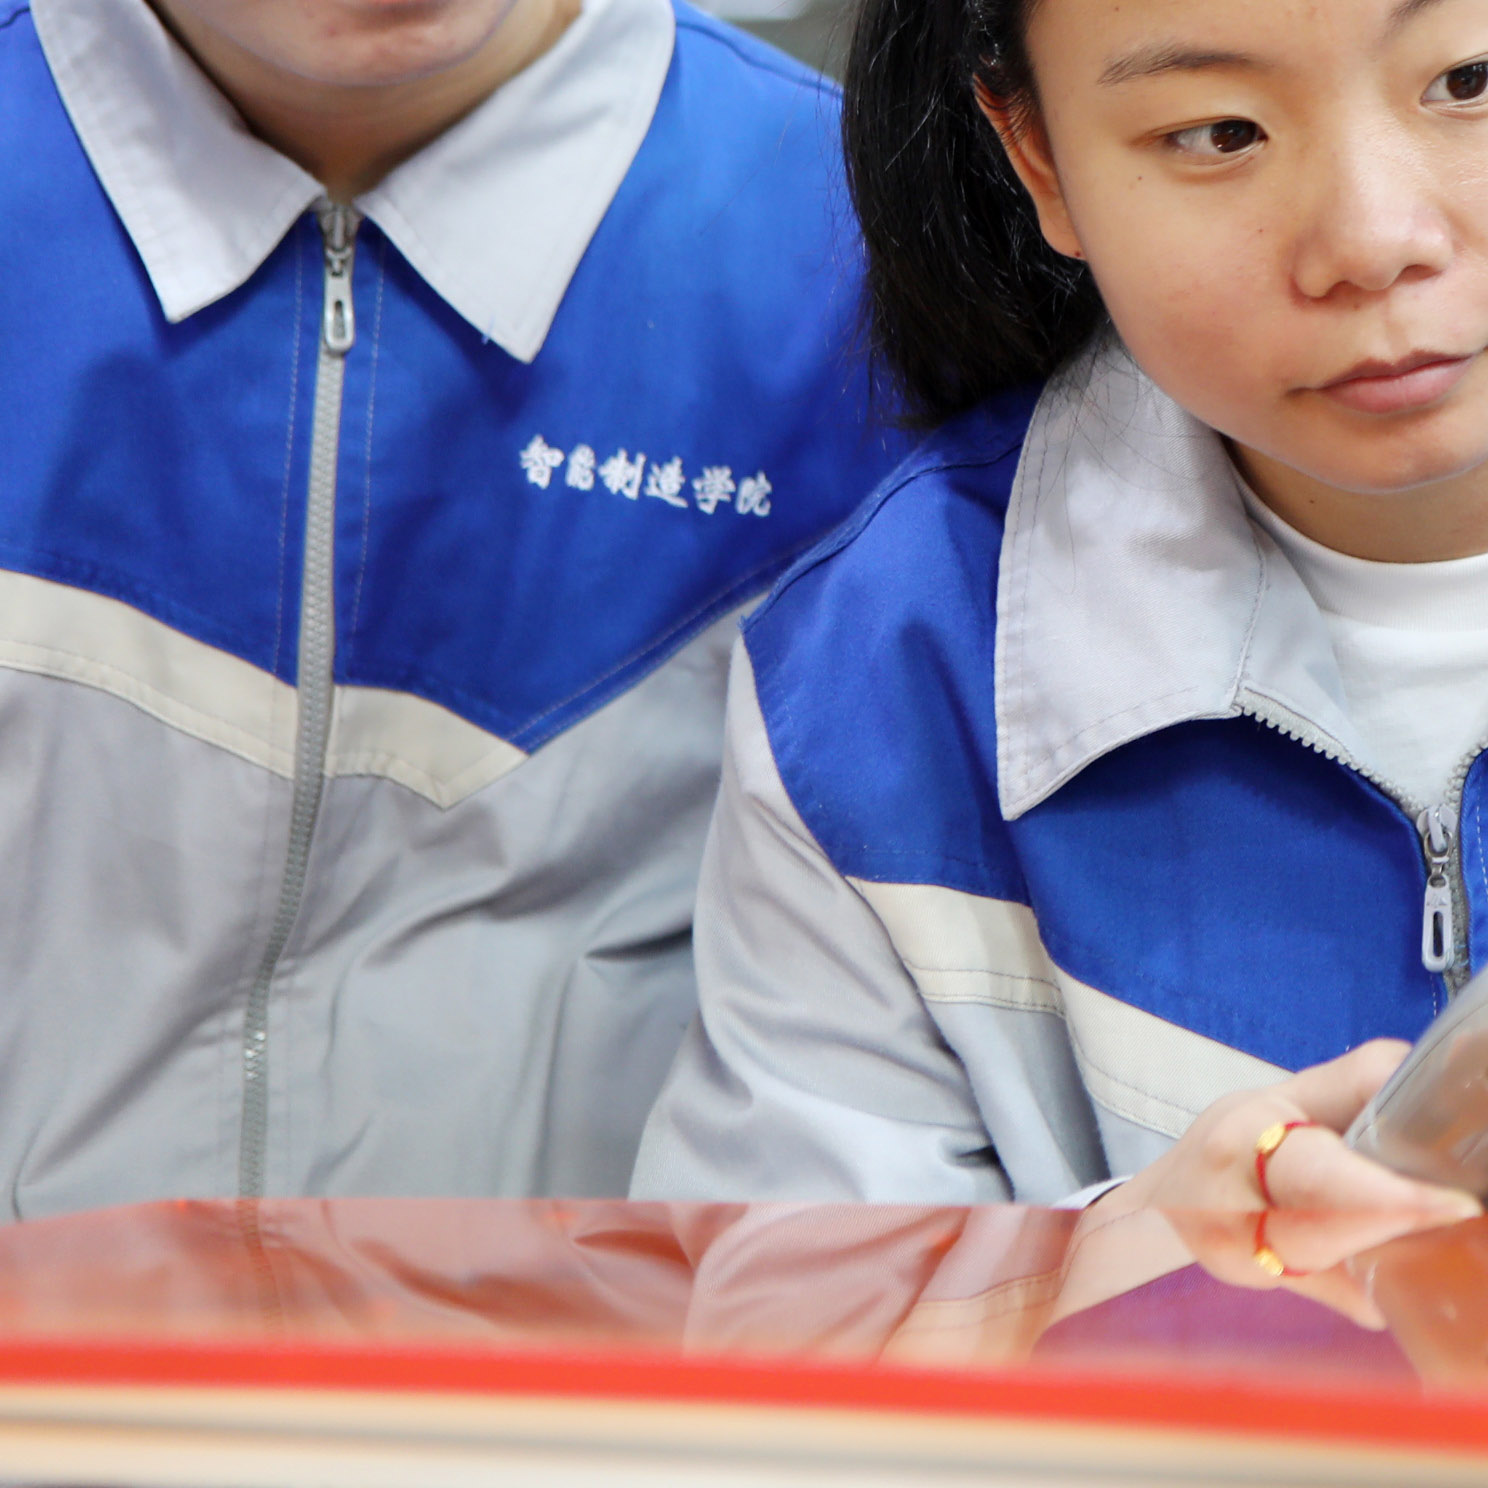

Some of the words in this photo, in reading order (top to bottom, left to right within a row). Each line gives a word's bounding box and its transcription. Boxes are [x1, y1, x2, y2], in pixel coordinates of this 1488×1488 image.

[519, 433, 772, 516] 智能制造学院
